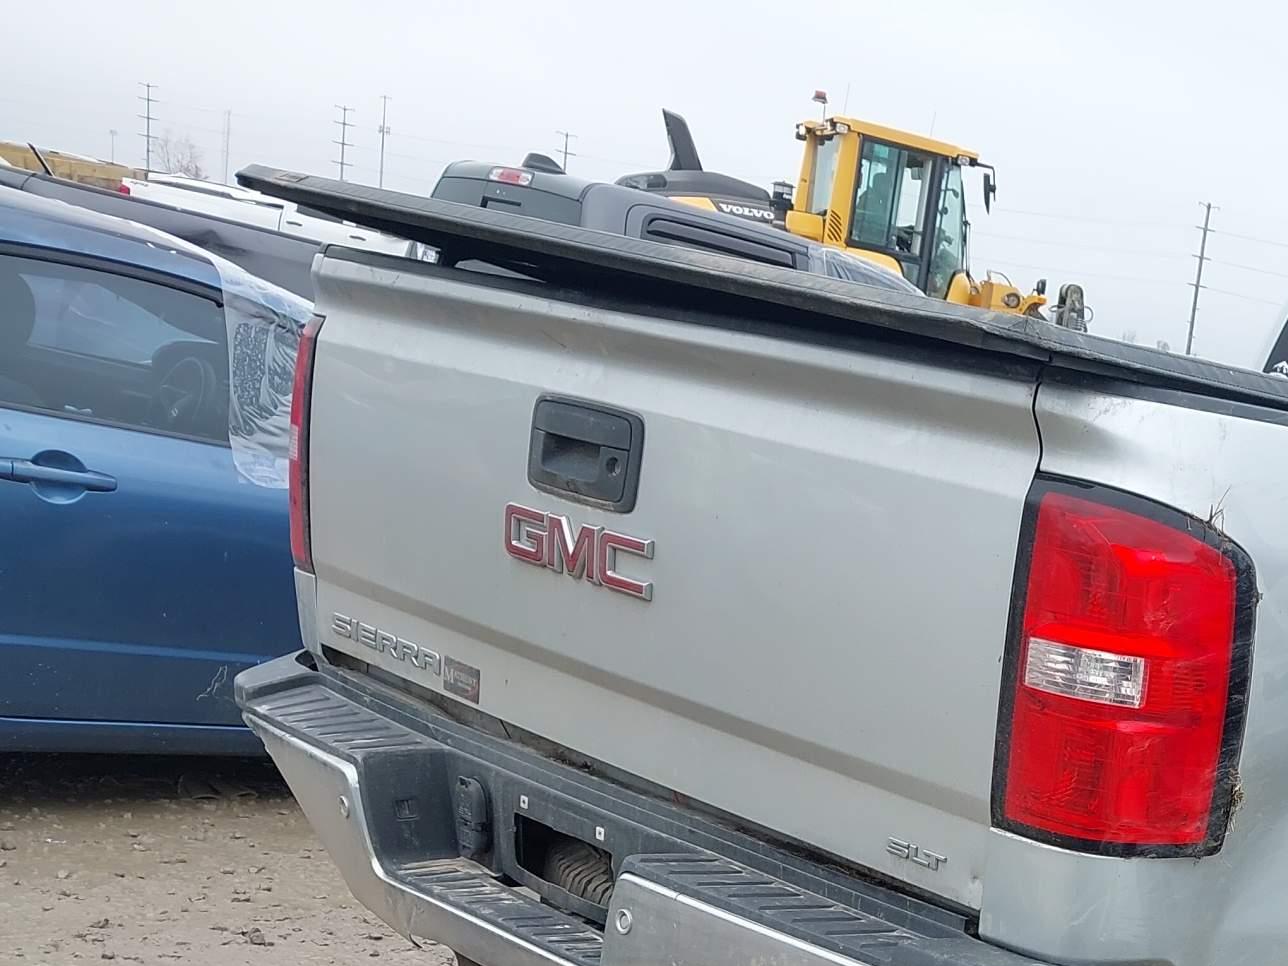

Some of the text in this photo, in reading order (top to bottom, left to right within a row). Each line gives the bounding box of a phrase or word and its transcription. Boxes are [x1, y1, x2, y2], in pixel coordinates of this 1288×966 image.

[719, 203, 774, 219] VOLVO
[504, 502, 655, 601] GMC
[331, 611, 441, 677] SIERRA
[885, 836, 948, 872] SLT
